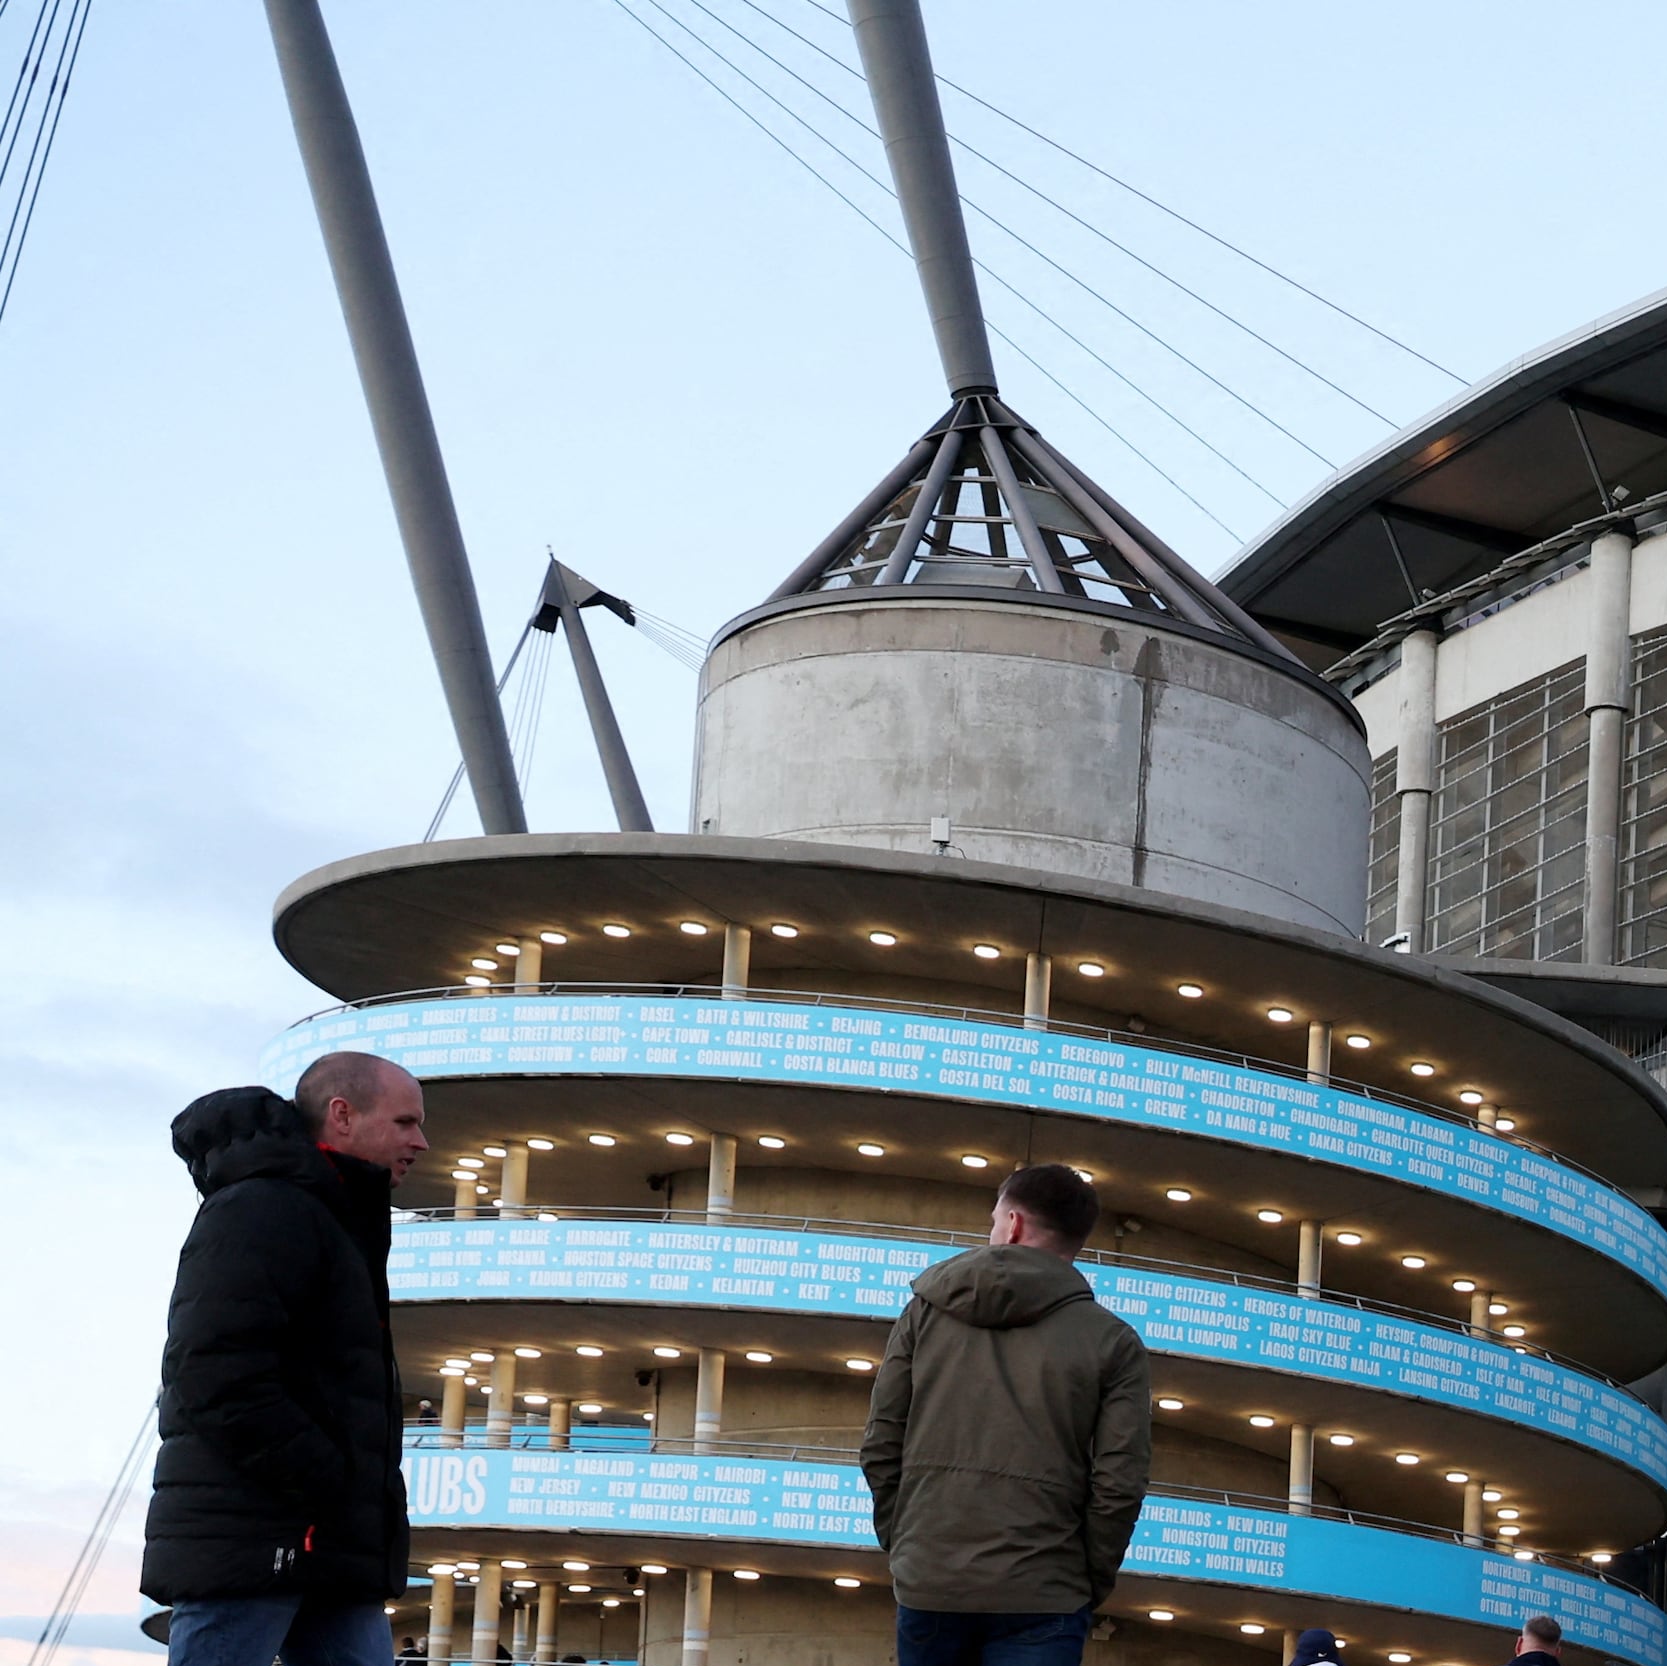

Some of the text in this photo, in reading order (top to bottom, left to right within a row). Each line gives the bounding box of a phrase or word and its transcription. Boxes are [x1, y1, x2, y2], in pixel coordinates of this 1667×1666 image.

[640, 1006, 1453, 1147] BASEL BATH & WILTSHIRE BEIJING BENGALURU CITYZENS BEREGOVO BILLY McNEILL RENFREWSHIRE BIRMINGHAM, ALABAMA
[642, 1027, 1357, 1138] CAPE TOWN CARLISLE & DISTRICT CARLOW CASTLETON CATTERICK & DARLINGTON CHADDERTON CHANDIGARH
[697, 1049, 1443, 1182] CORNWALL COSTA BLANCA BLUES COSTA DEL SOL COSTA RICA CREWE DA NANG & HUE DAKAR CITYZENS DENTON
[618, 1252, 860, 1282] SPACE CITYZENS HUIZHOU CITY BLUES
[648, 1232, 928, 1268] HATTERSLEY MOTTRAM HAUGHTON GREEN
[649, 1273, 688, 1291] KEDAH
[712, 1277, 773, 1296] KELANTAN
[798, 1283, 829, 1301] KENT
[855, 1287, 893, 1305] KINGS
[1116, 1276, 1360, 1334] HELLENIC CITIZENS HEROES OF WATERLOO
[1168, 1304, 1399, 1362] INDIANAPOLIS IRAQI SKY BLUE IRLAM
[1145, 1322, 1437, 1391] KUALA LUMPUR LAGOS CITYZENS NAIJA LANSING
[400, 1456, 487, 1515] LUBS
[650, 1462, 697, 1481] NAGPUR
[715, 1467, 766, 1485] NAIROBI
[783, 1471, 838, 1490] NANJING
[640, 1483, 811, 1508] MEXICO CITYZENS NEW
[670, 1506, 699, 1523] EAST
[701, 1508, 756, 1526] ENGLAND
[772, 1512, 814, 1530] NORTH
[819, 1515, 850, 1532] EAST
[1227, 1515, 1254, 1533] NEW
[1256, 1519, 1287, 1537] DELHI
[1162, 1528, 1285, 1557] NONGSTOIN CITYZENS
[1135, 1545, 1283, 1577] CITYZENS NORTH WALES
